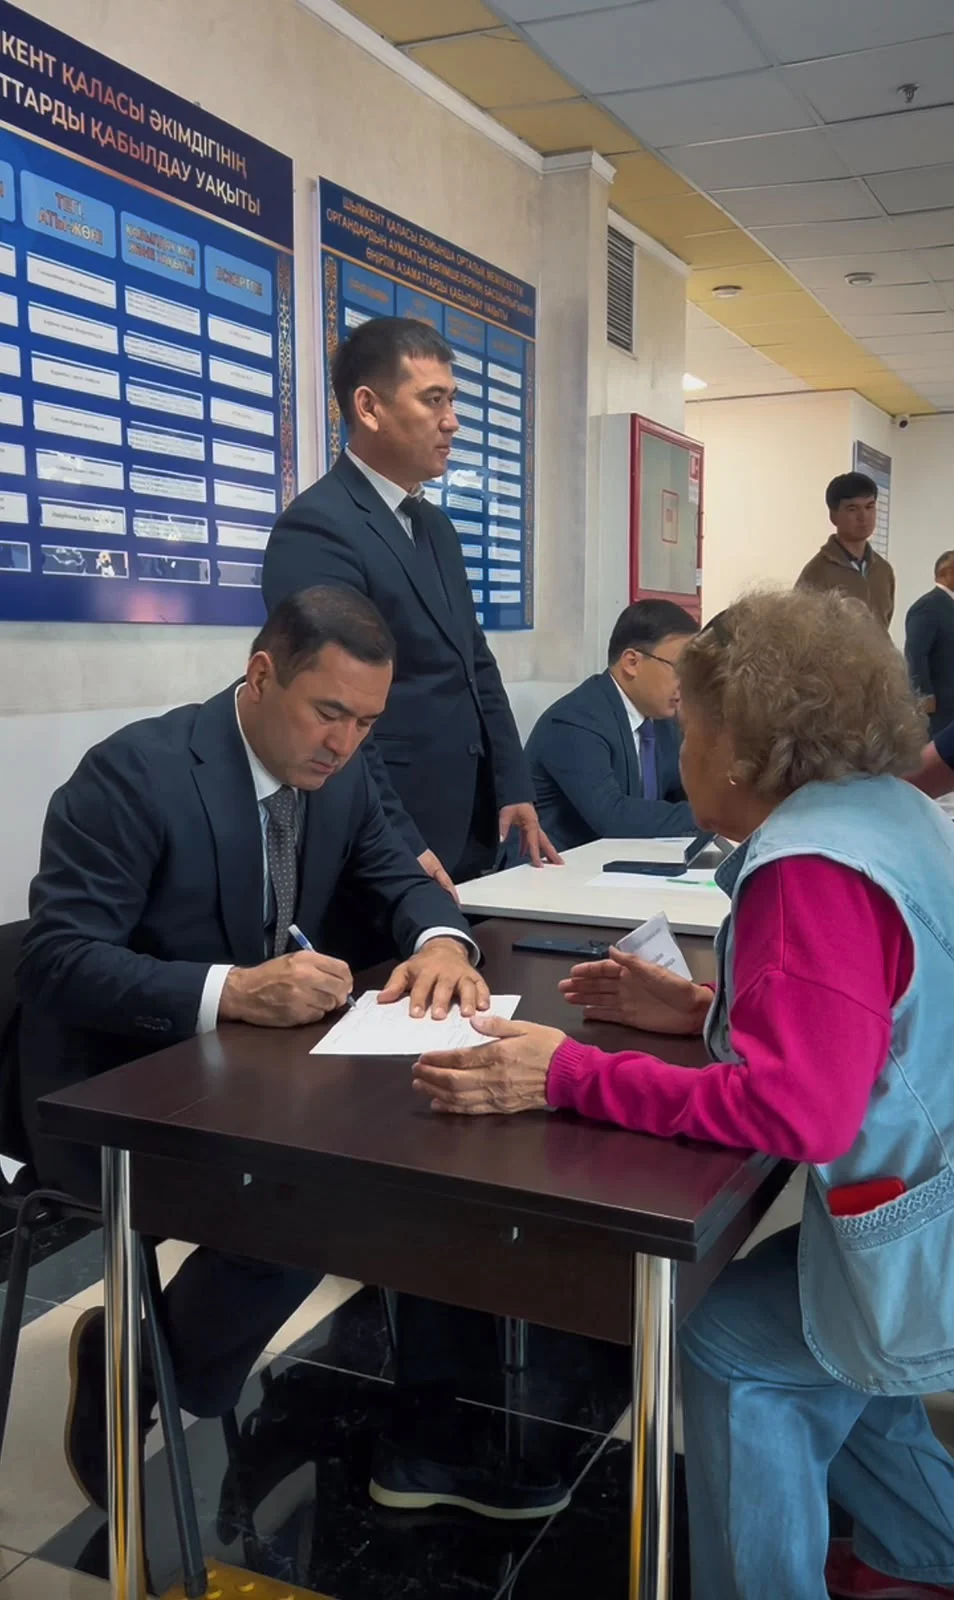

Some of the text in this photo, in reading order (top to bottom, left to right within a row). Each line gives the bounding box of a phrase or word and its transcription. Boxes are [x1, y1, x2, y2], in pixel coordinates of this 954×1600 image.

[0, 30, 248, 181] КЕНТ ҚАЛАСЫ ӘКІМДІГІНІҢ
[91, 116, 192, 183] ҚАБЫЛДАУ
[195, 167, 261, 217] УАҚЫТЫ
